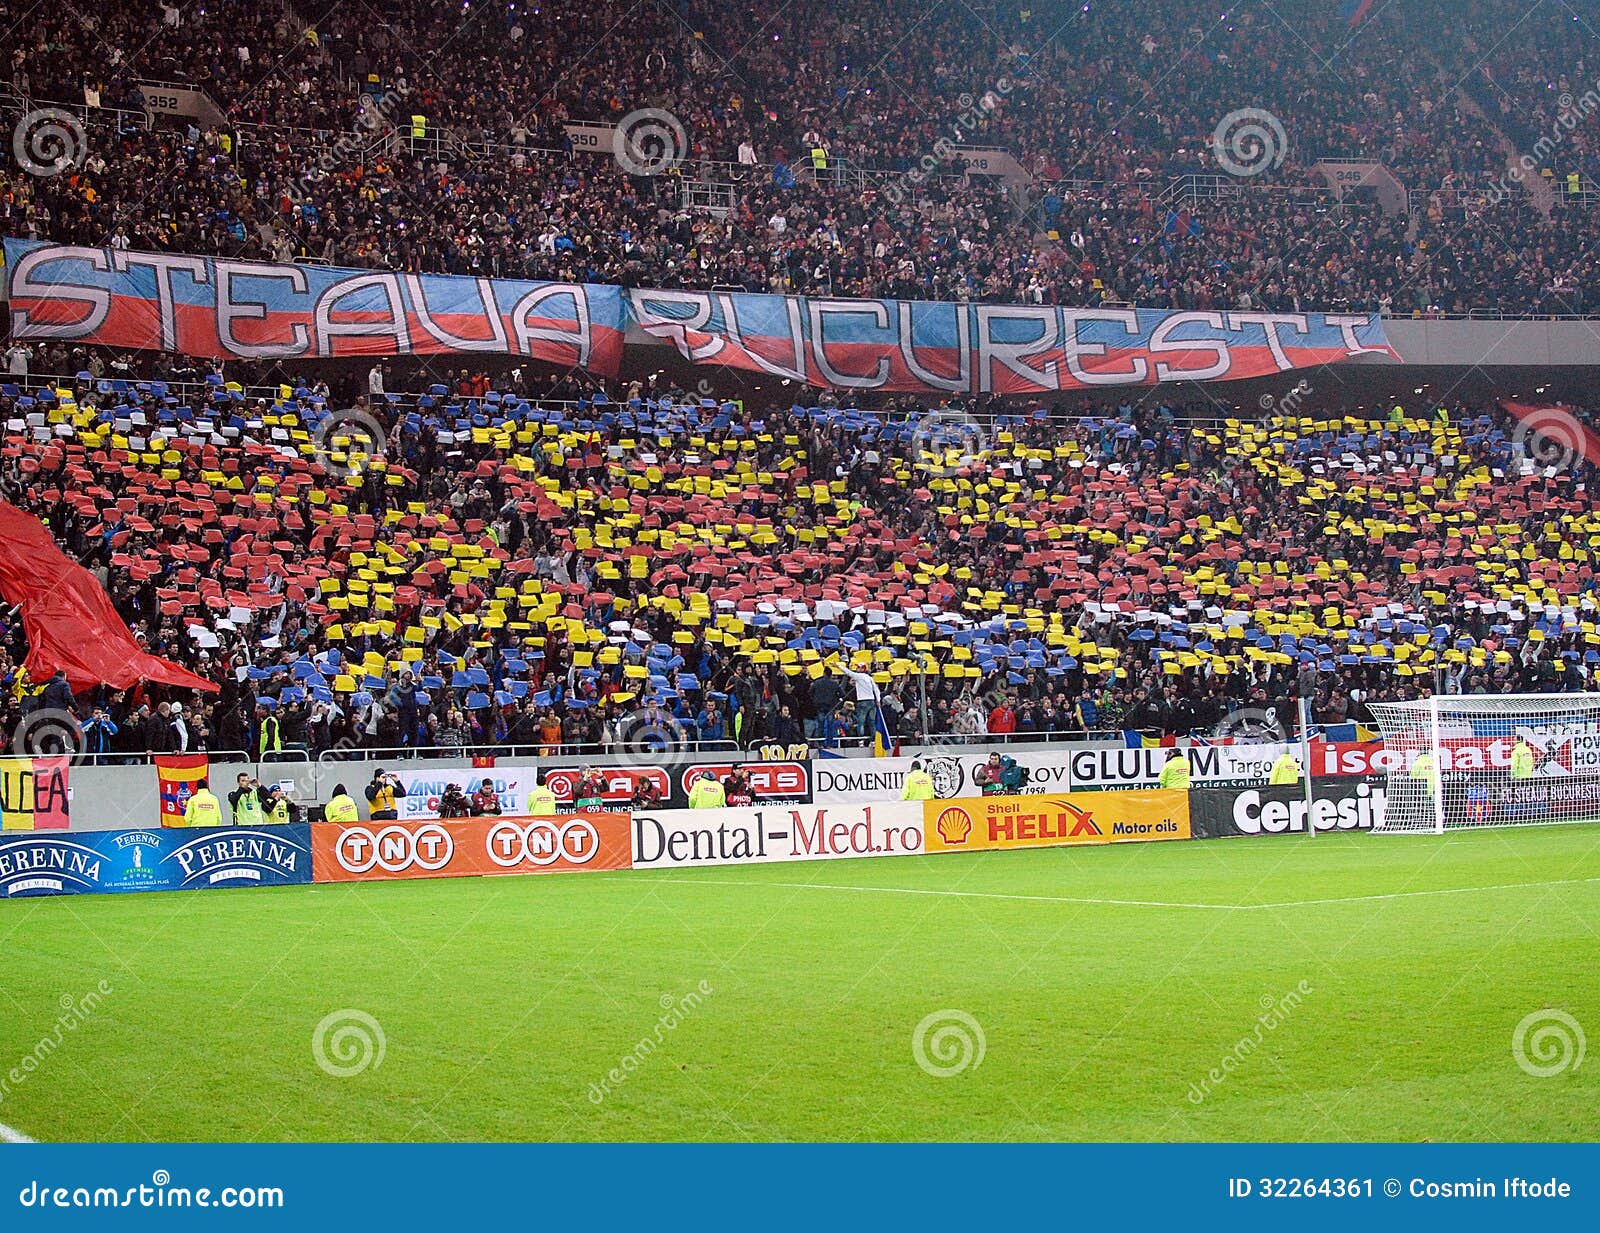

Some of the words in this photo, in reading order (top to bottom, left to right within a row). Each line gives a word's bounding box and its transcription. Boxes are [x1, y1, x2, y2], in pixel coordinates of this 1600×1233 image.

[149, 95, 178, 109] 352
[571, 134, 598, 146] 350
[1336, 170, 1361, 181] 346
[9, 245, 592, 367] STEAUA
[629, 288, 1388, 392] BUCURESTI
[1072, 747, 1220, 781] GLULM
[0, 767, 69, 816] LCEA
[465, 777, 507, 795] LAD
[587, 805, 600, 813] 059
[987, 804, 1020, 814] Shell
[987, 809, 1100, 841] HELIX
[1232, 783, 1388, 834] Ceresit
[116, 834, 160, 848] PERENNA
[491, 825, 593, 860] TNT
[632, 807, 922, 863] Dental-Med.ro
[1112, 821, 1152, 835] Motor
[1156, 818, 1178, 833] oils
[0, 848, 100, 881] ERENNA
[174, 839, 296, 878] PERENNA
[342, 831, 448, 866] TNT
